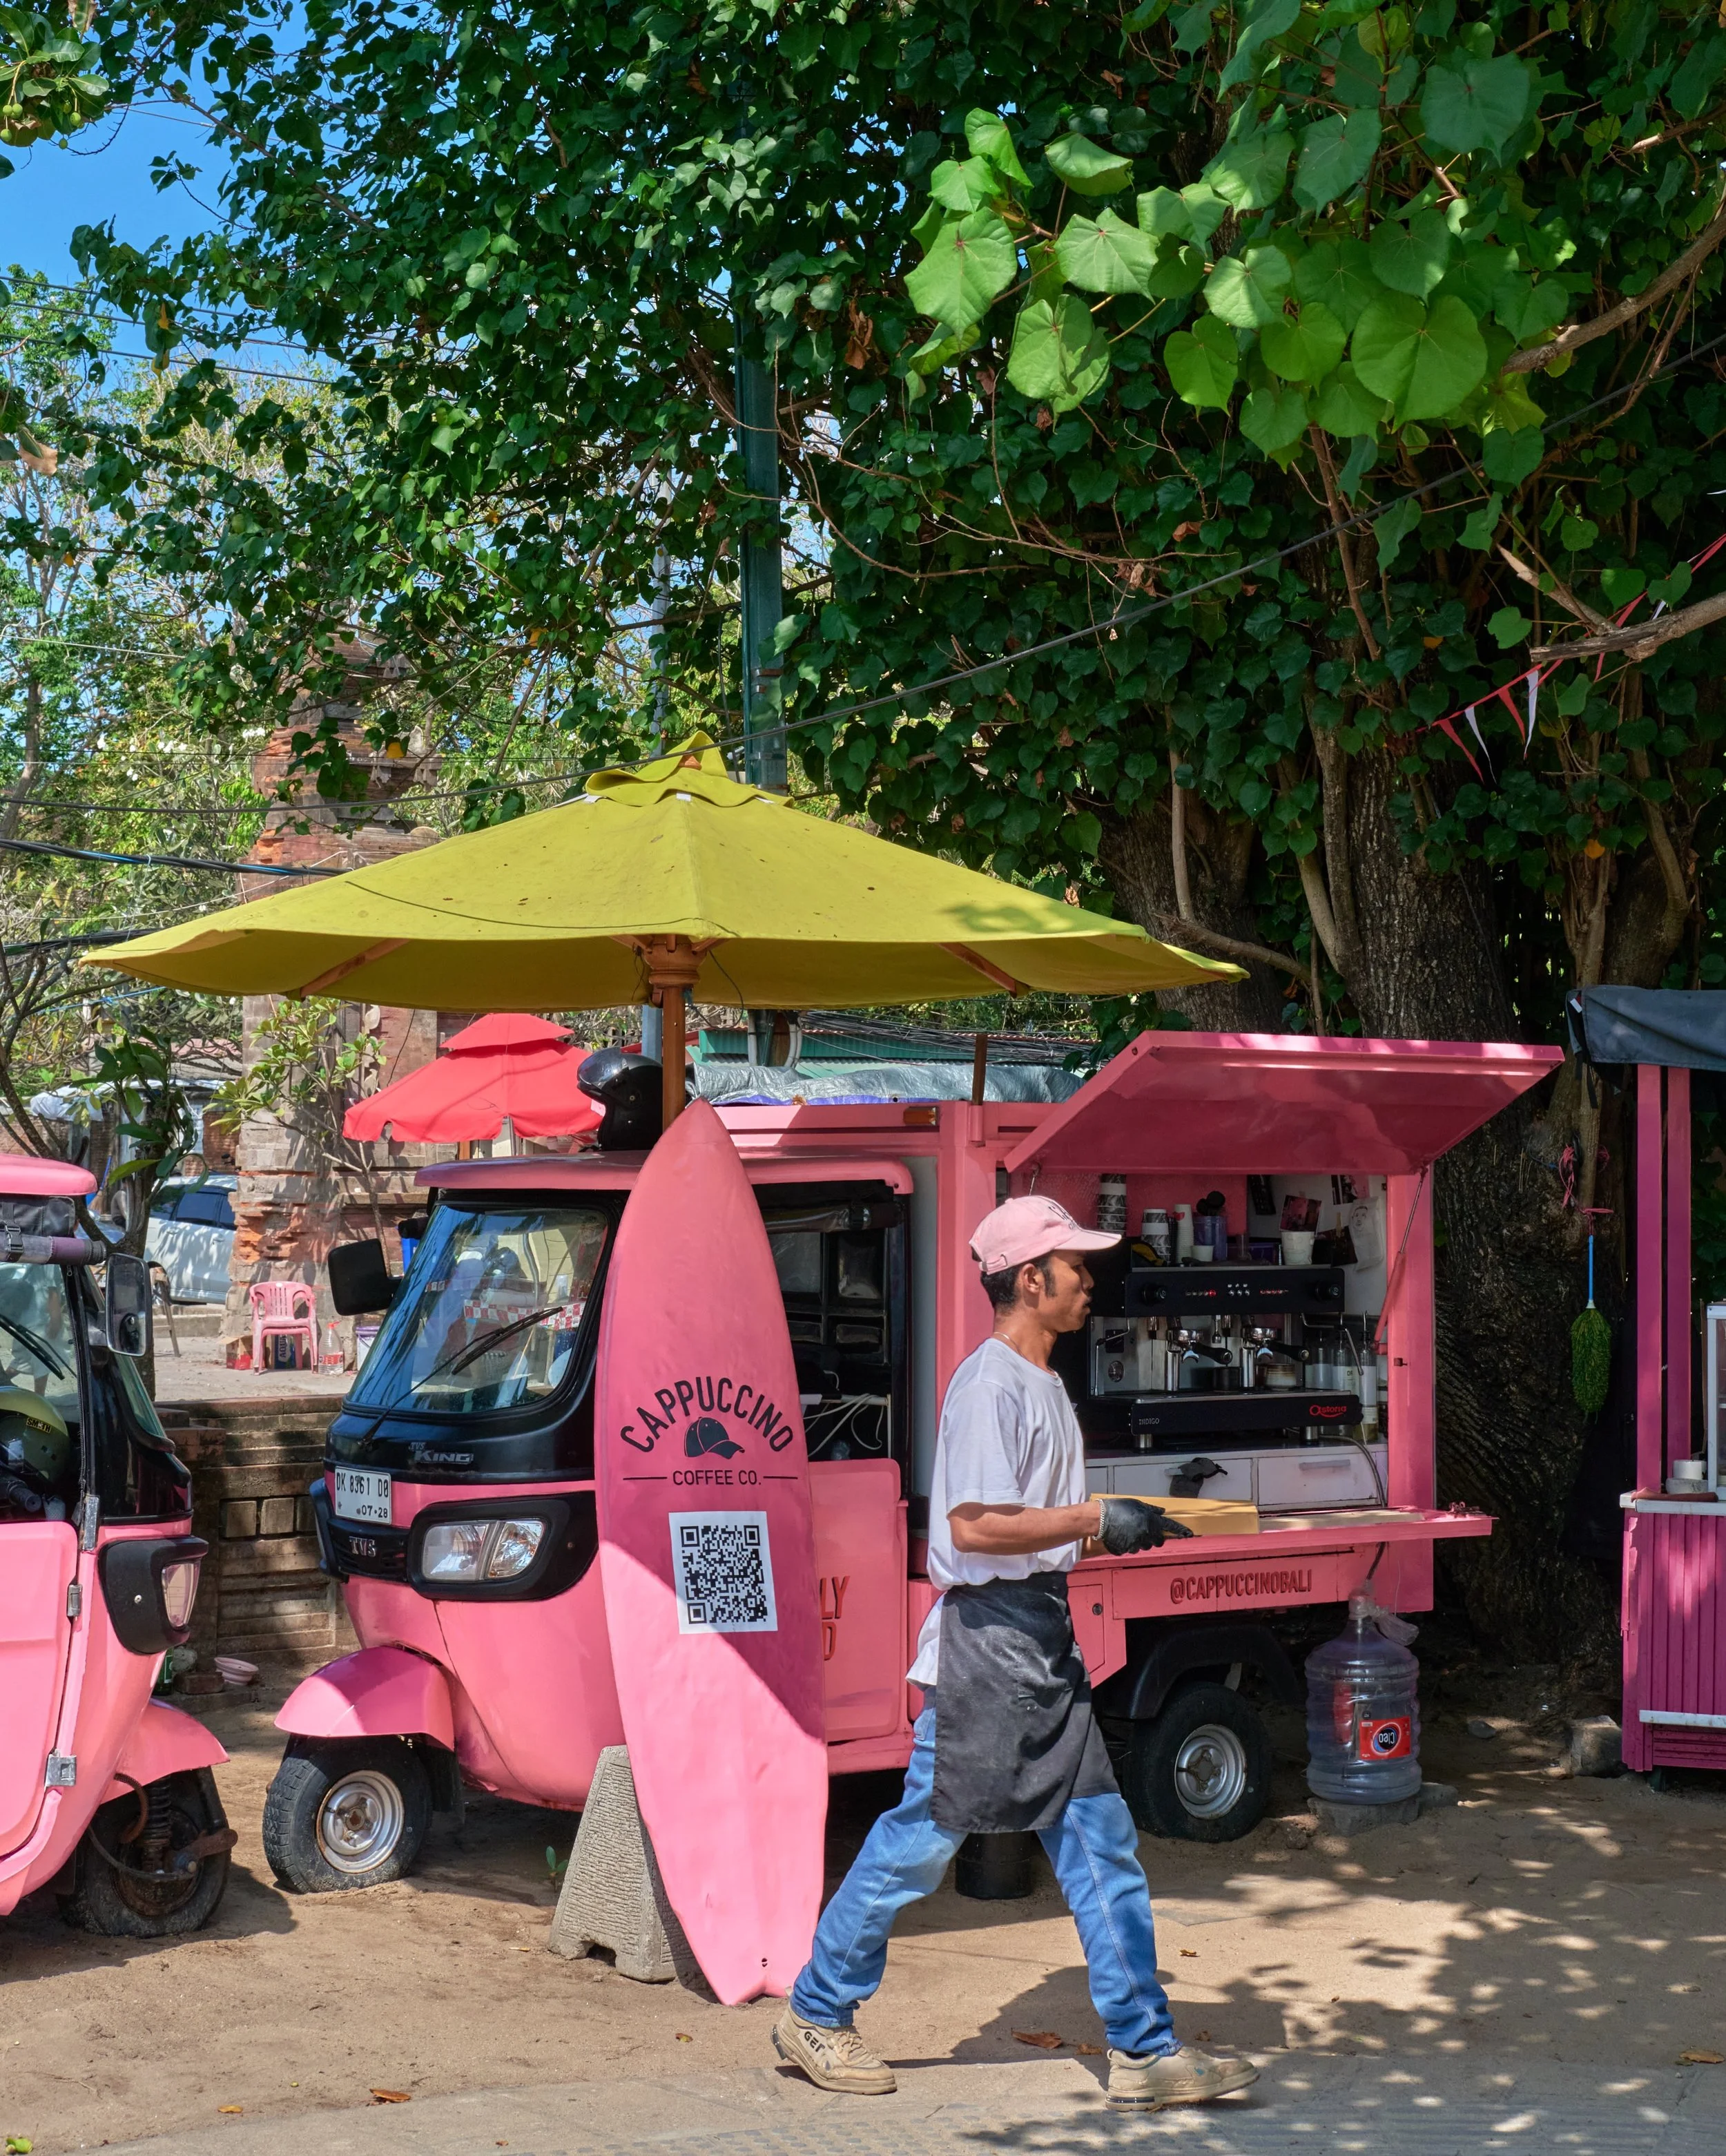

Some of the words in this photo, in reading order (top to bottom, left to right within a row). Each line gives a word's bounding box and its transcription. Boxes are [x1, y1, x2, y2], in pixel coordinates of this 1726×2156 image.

[620, 1376, 793, 1452] CAPPUCCINO
[27, 1418, 51, 1433] SMTH
[409, 1441, 426, 1450] TVS
[336, 1472, 346, 1492] DK
[350, 1475, 370, 1496] 8361
[672, 1470, 734, 1485] COFFEE
[738, 1470, 762, 1485] CO.
[349, 1536, 376, 1557] TVS
[1170, 1569, 1312, 1604] @CAPPUCCINOBALI
[1379, 1732, 1395, 1744] Cleo
